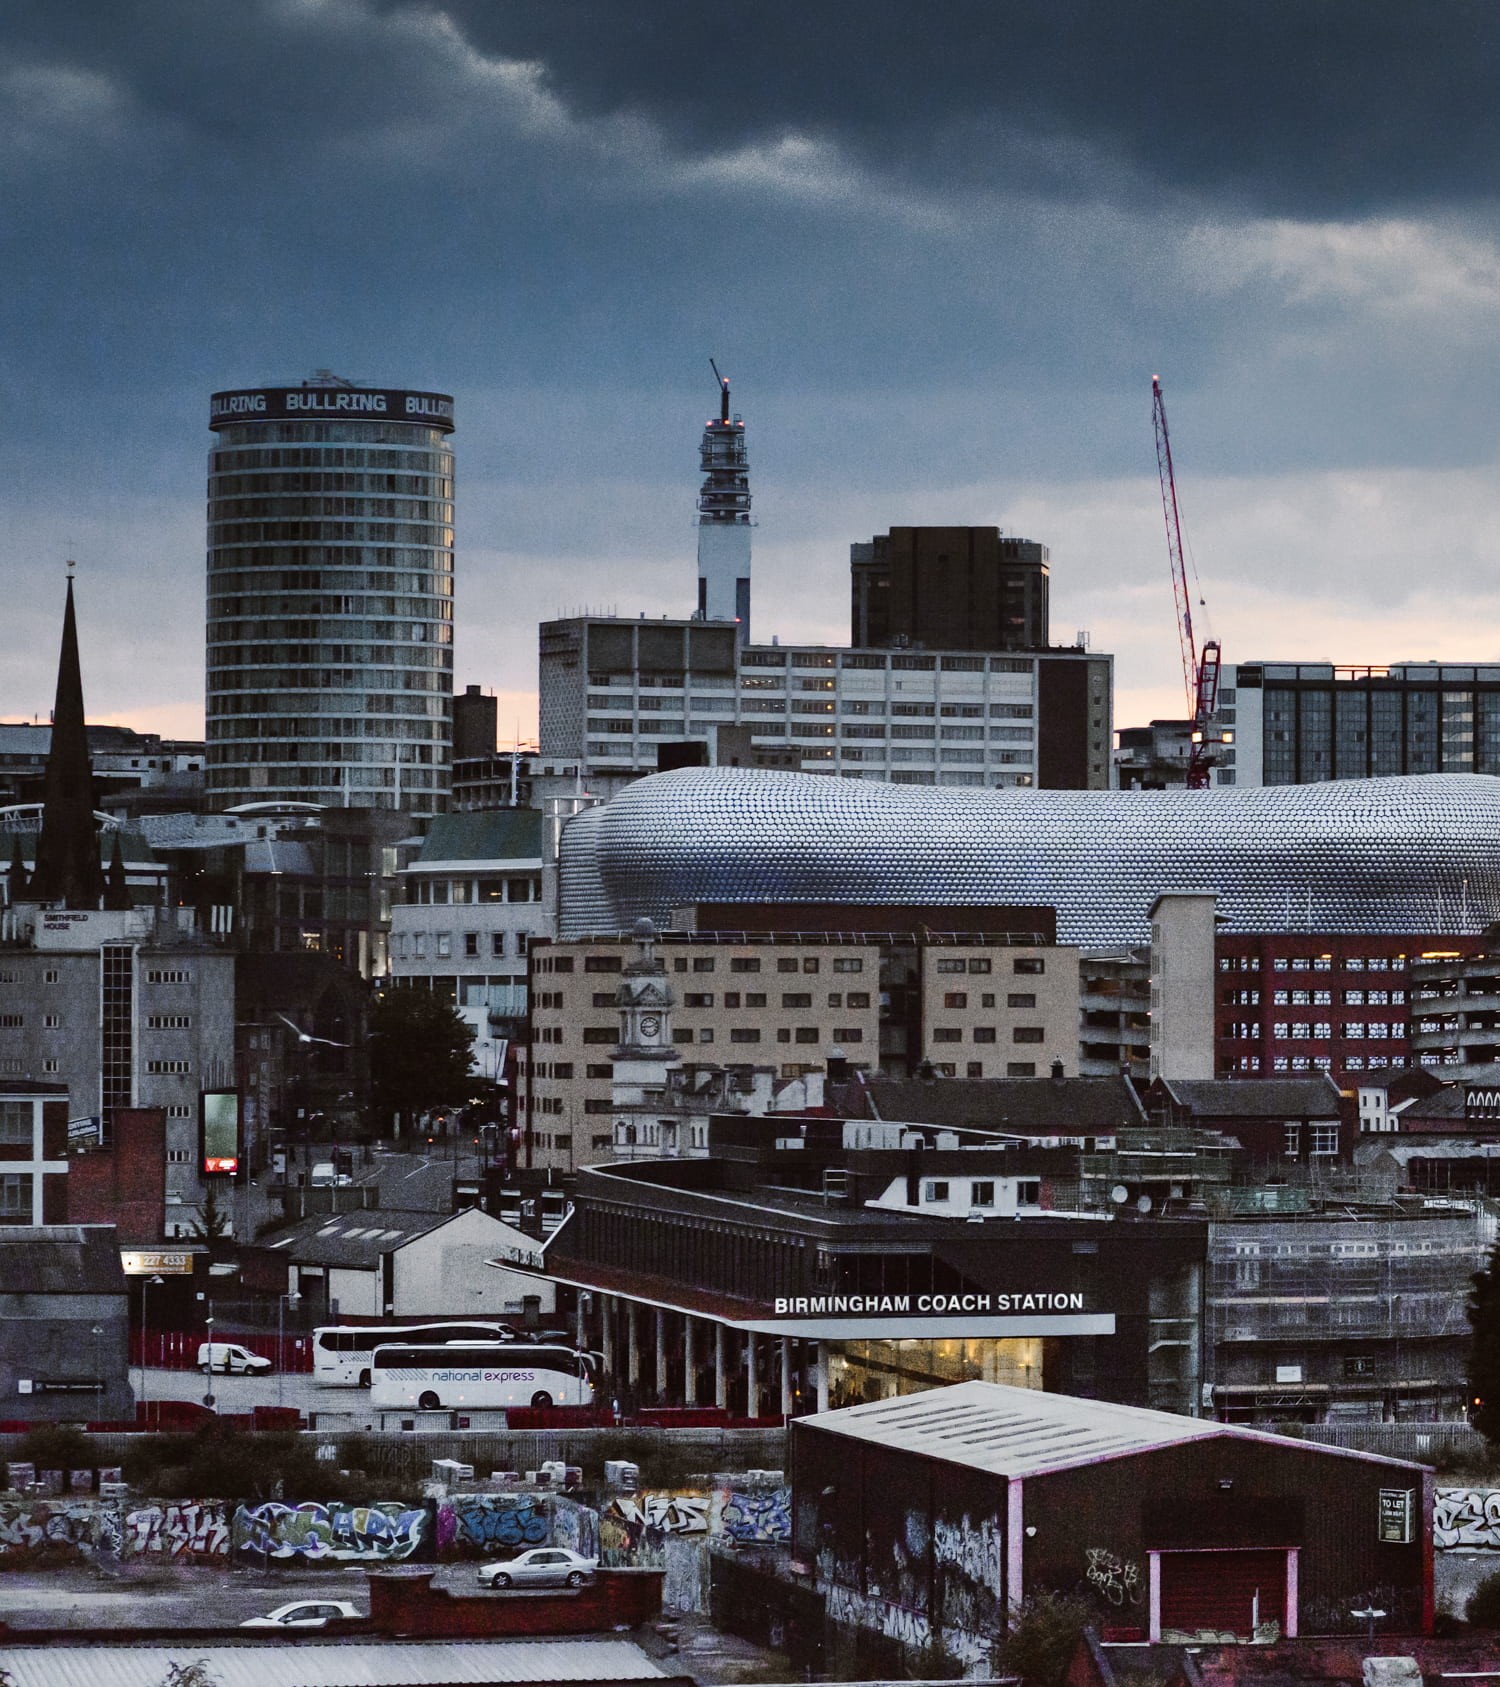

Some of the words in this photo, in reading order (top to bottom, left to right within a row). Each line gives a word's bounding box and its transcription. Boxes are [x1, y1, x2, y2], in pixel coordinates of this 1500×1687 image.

[212, 394, 267, 417] ULLRING
[286, 393, 387, 410] BULLRING
[44, 914, 88, 922] SMITHFIELD
[44, 922, 71, 930] HOUSE
[144, 1255, 160, 1266] 227
[162, 1255, 186, 1266] 4333
[774, 1296, 910, 1314] BIRMINGHAM
[917, 1294, 991, 1312] COACH
[998, 1293, 1084, 1310] STATION
[432, 1370, 482, 1382] national
[484, 1371, 535, 1384] express
[1382, 1499, 1392, 1508] TO
[1393, 1500, 1405, 1509] LET
